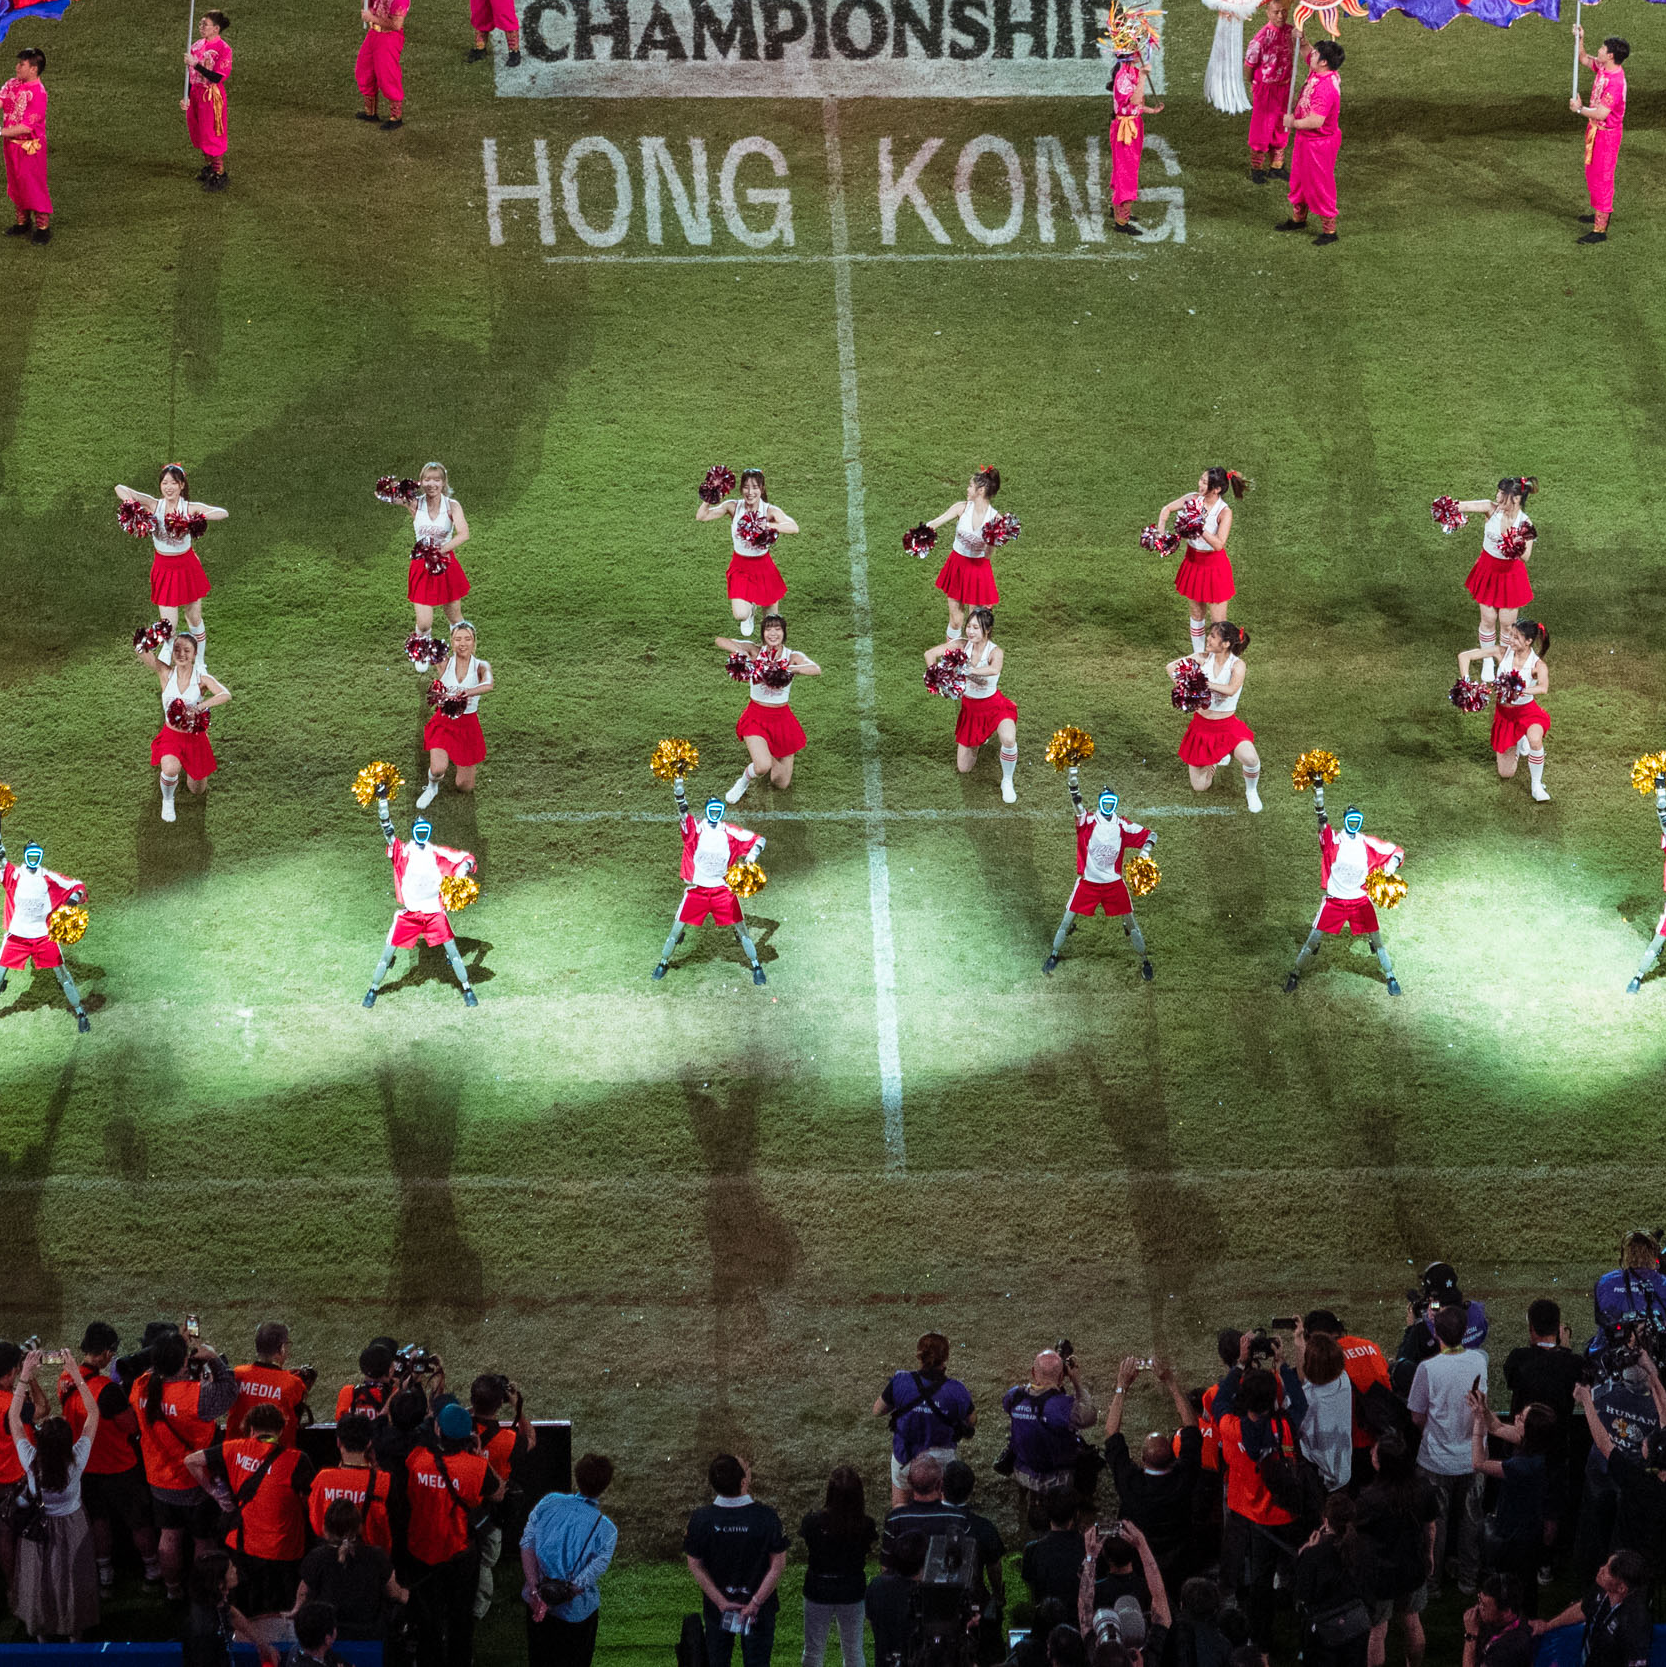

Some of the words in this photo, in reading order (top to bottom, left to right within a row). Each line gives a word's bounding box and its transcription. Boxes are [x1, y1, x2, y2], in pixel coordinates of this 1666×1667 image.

[481, 134, 796, 248] HONG
[878, 134, 1188, 246] KONG
[239, 1381, 282, 1401] MEDIA
[1605, 1404, 1658, 1427] HUMAN
[722, 1525, 750, 1534] CATHAY
